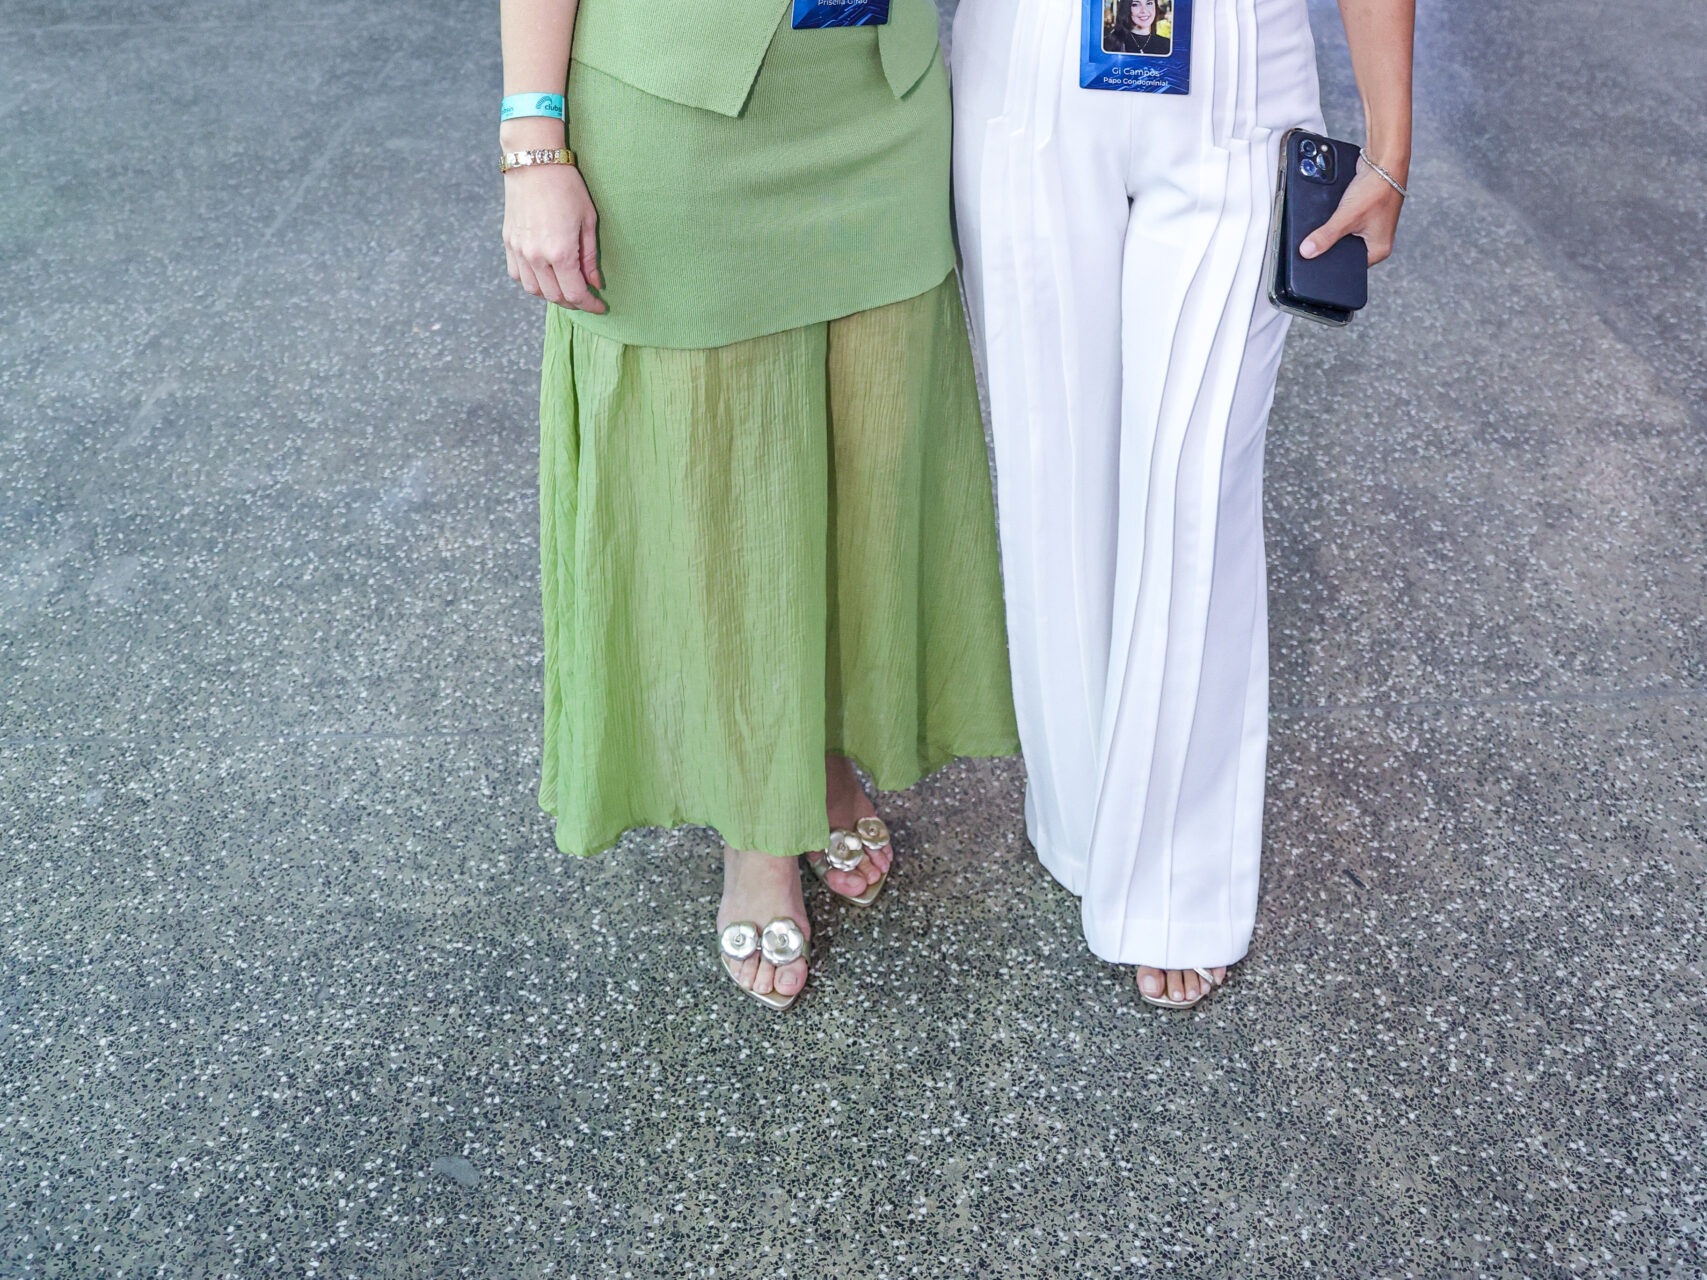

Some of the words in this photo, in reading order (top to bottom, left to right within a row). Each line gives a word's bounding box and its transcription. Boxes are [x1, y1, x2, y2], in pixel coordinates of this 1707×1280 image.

[1111, 66, 1122, 76] Gi
[1123, 67, 1161, 78] Campos
[1103, 76, 1122, 85] Papo
